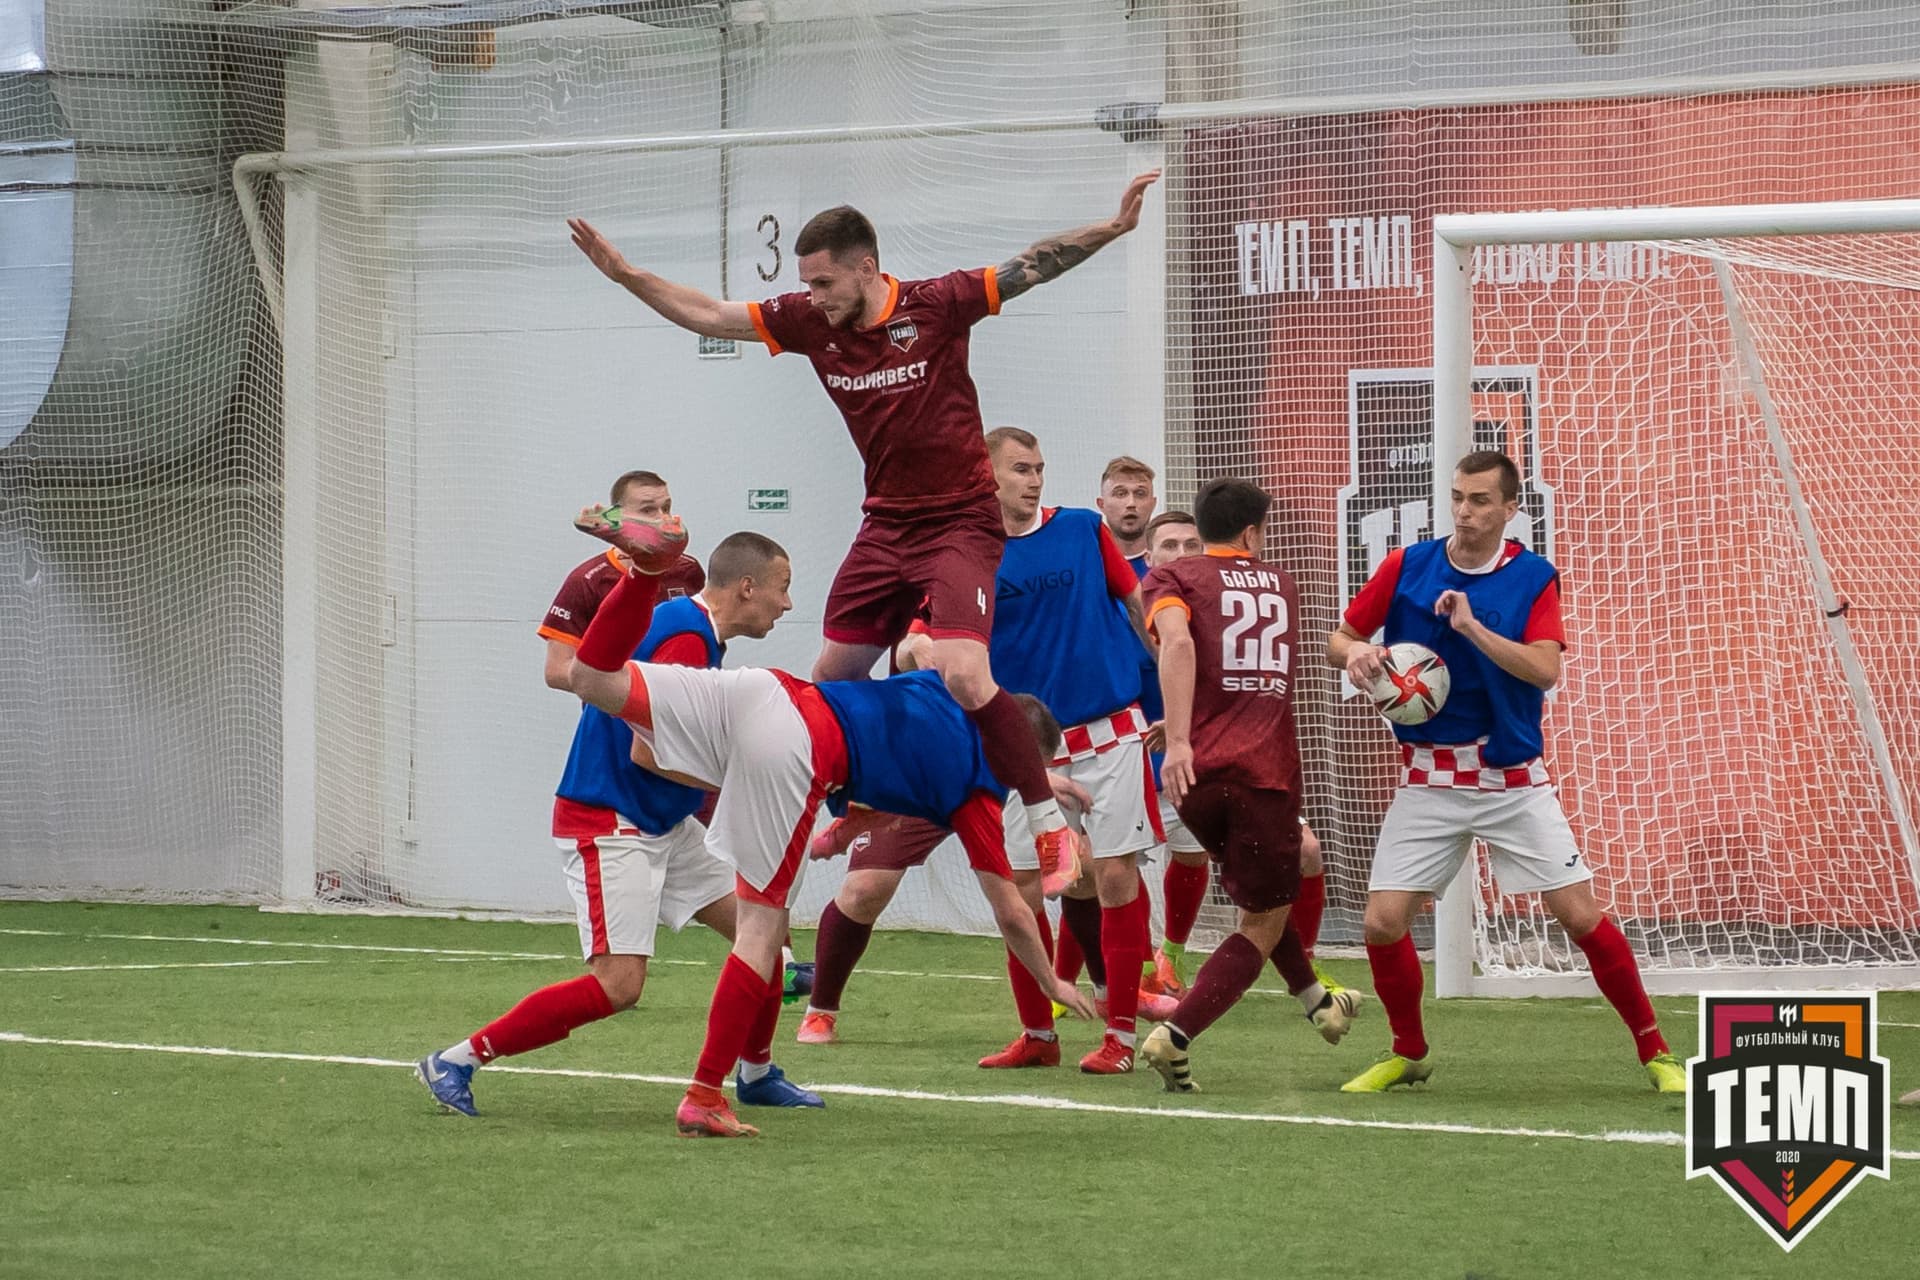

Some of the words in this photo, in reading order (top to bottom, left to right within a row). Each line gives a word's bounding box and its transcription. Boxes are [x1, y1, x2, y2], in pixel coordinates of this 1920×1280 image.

[756, 214, 782, 283] 3
[1329, 215, 1424, 297] ТЕМП,
[1024, 569, 1075, 593] VIGO
[1219, 569, 1281, 593] БАБИЧ
[977, 586, 987, 616] 4
[1221, 590, 1290, 676] 22
[1222, 676, 1289, 695] SEUS
